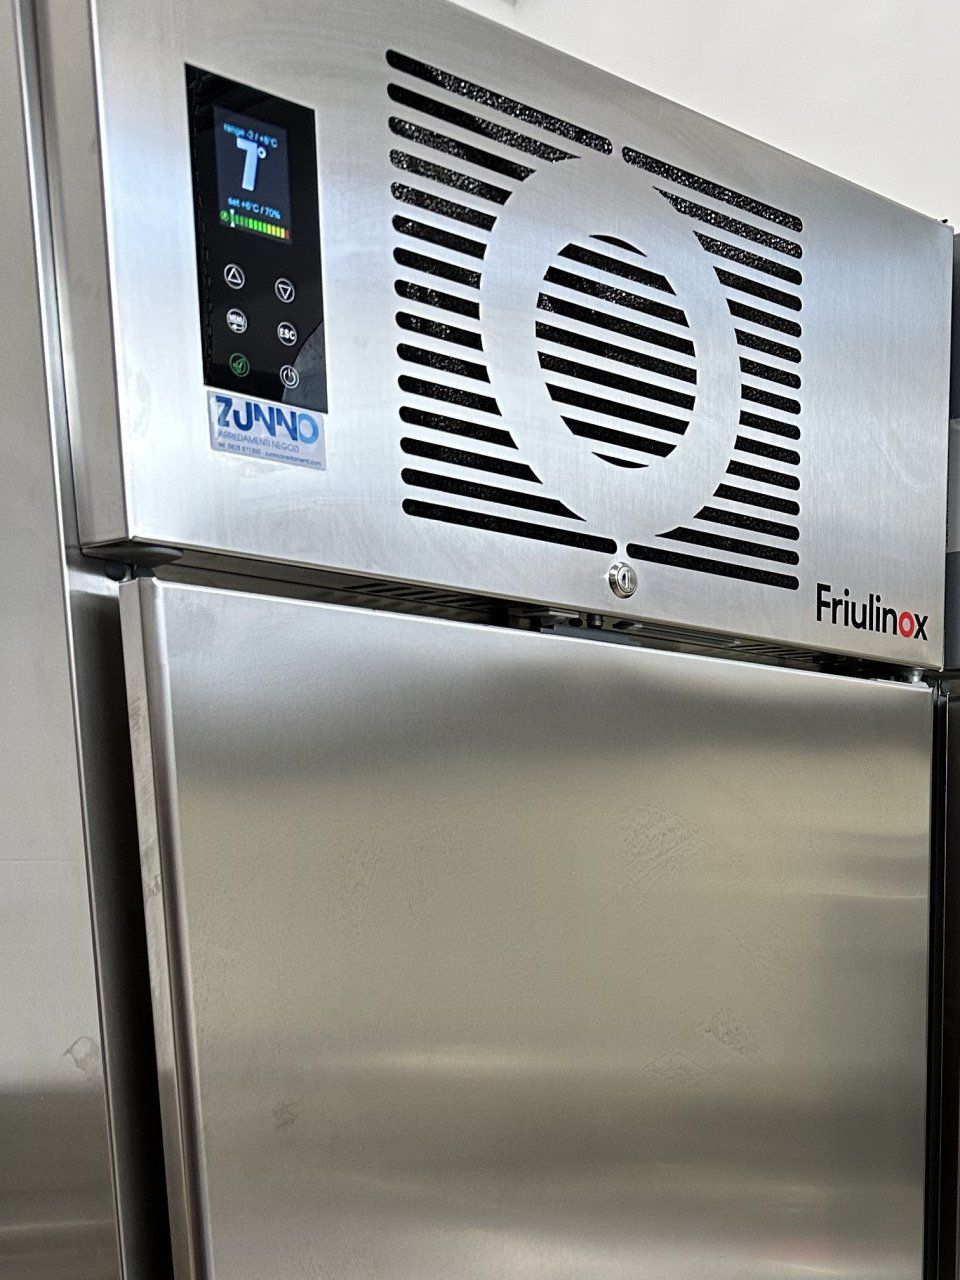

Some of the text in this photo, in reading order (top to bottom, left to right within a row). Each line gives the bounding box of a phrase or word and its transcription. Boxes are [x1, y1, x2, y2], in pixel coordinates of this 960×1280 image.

[279, 327, 295, 341] ESC
[215, 395, 319, 445] ZUNNO
[218, 430, 300, 454] ARREDAMENTI NEGOZI
[817, 582, 929, 642] Friulinox
